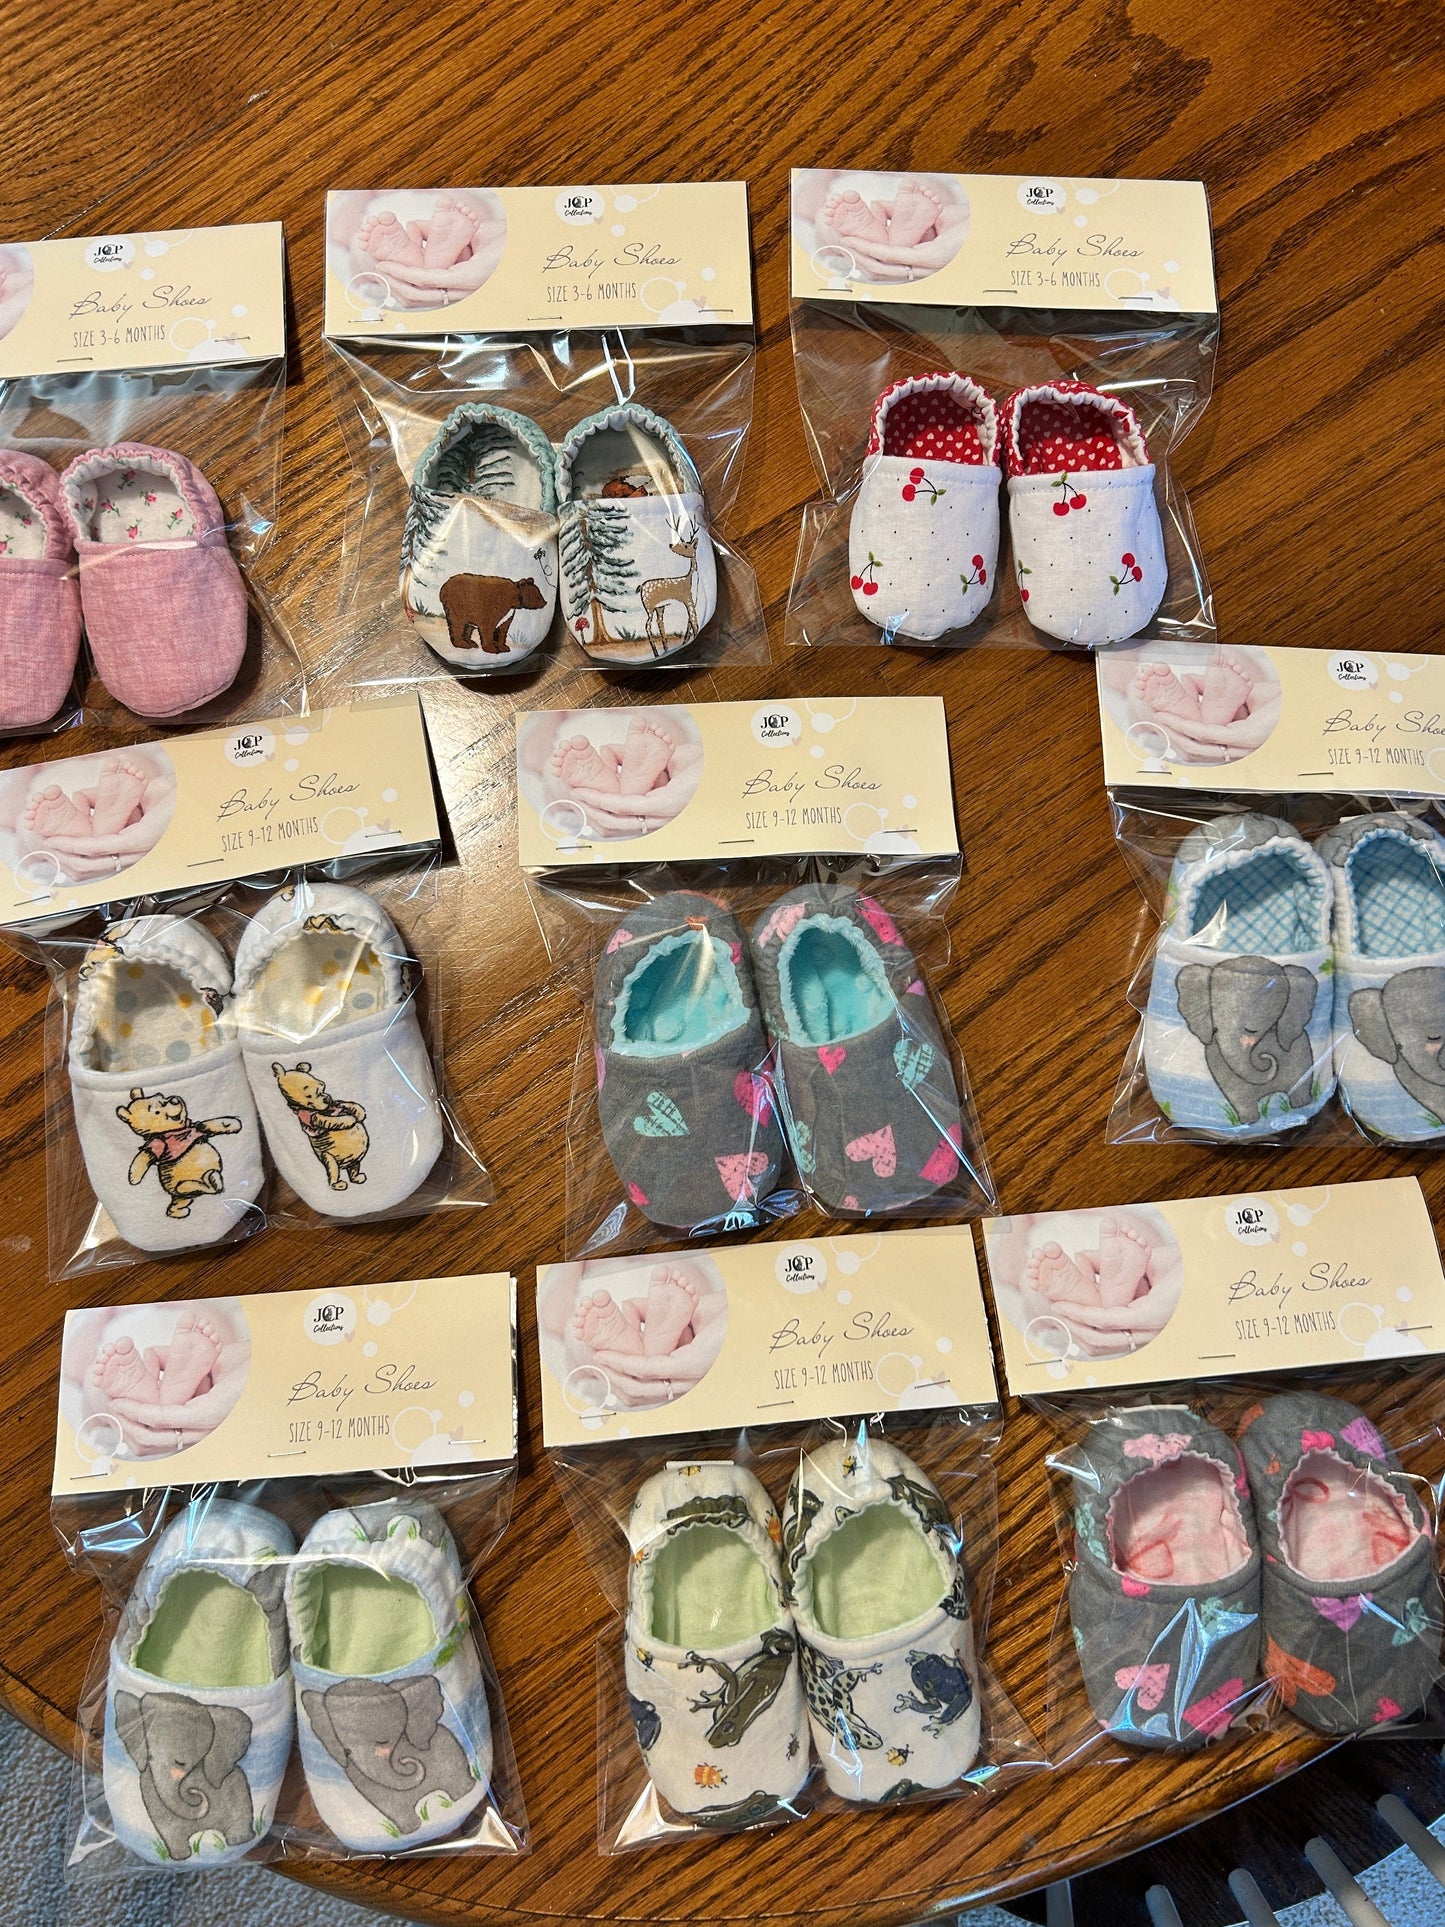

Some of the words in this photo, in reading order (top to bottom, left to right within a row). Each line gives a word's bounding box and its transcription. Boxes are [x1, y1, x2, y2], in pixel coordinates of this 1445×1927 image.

[542, 245, 604, 278] Baby
[614, 243, 682, 266] Shoes
[1005, 233, 1068, 266] Baby
[1077, 234, 1144, 257] Shoes
[547, 286, 568, 302] SIZE
[574, 285, 592, 301] 3-6
[598, 283, 636, 299] MONTHS
[1011, 270, 1032, 286] SIZE
[1038, 271, 1057, 286] 3-6
[1062, 272, 1100, 287] MONTHS
[68, 291, 133, 323] Baby
[142, 285, 212, 308] Shoes
[74, 331, 95, 347] SIZE
[101, 330, 120, 345] 3-6
[126, 325, 165, 343] MONTHS
[761, 730, 790, 738] Collections
[1322, 709, 1387, 742] Baby
[1396, 711, 1445, 735] Shoe
[1328, 748, 1351, 765] SIZE
[1356, 748, 1381, 763] 9-12
[1386, 748, 1425, 766] MONTHS
[217, 789, 280, 820] Baby
[289, 773, 360, 800] Shoes
[742, 769, 806, 803] Baby
[815, 765, 883, 790] Shoes
[746, 811, 768, 829] SIZE
[773, 809, 797, 827] 9-12
[802, 807, 842, 825] MONTHS
[221, 832, 244, 852] SIZE
[250, 825, 273, 846] 9-12
[278, 817, 319, 840] MONTHS
[786, 1273, 815, 1282] Collections
[1228, 1270, 1292, 1309] Baby
[1301, 1262, 1372, 1291] Shoes
[313, 1324, 343, 1333] Collections
[769, 1318, 833, 1358] Baby
[844, 1311, 914, 1340] Shoes
[1236, 1318, 1260, 1340] SIZE
[1264, 1315, 1290, 1336] 9-12
[1294, 1311, 1336, 1334] MONTHS
[287, 1371, 354, 1412] Baby
[365, 1364, 438, 1394] Shoes
[774, 1368, 797, 1390] SIZE
[802, 1364, 826, 1386] 9-12
[833, 1360, 874, 1383] MONTHS
[289, 1421, 312, 1443] SIZE
[318, 1419, 343, 1440] 9-12
[349, 1415, 390, 1438] MONTHS
